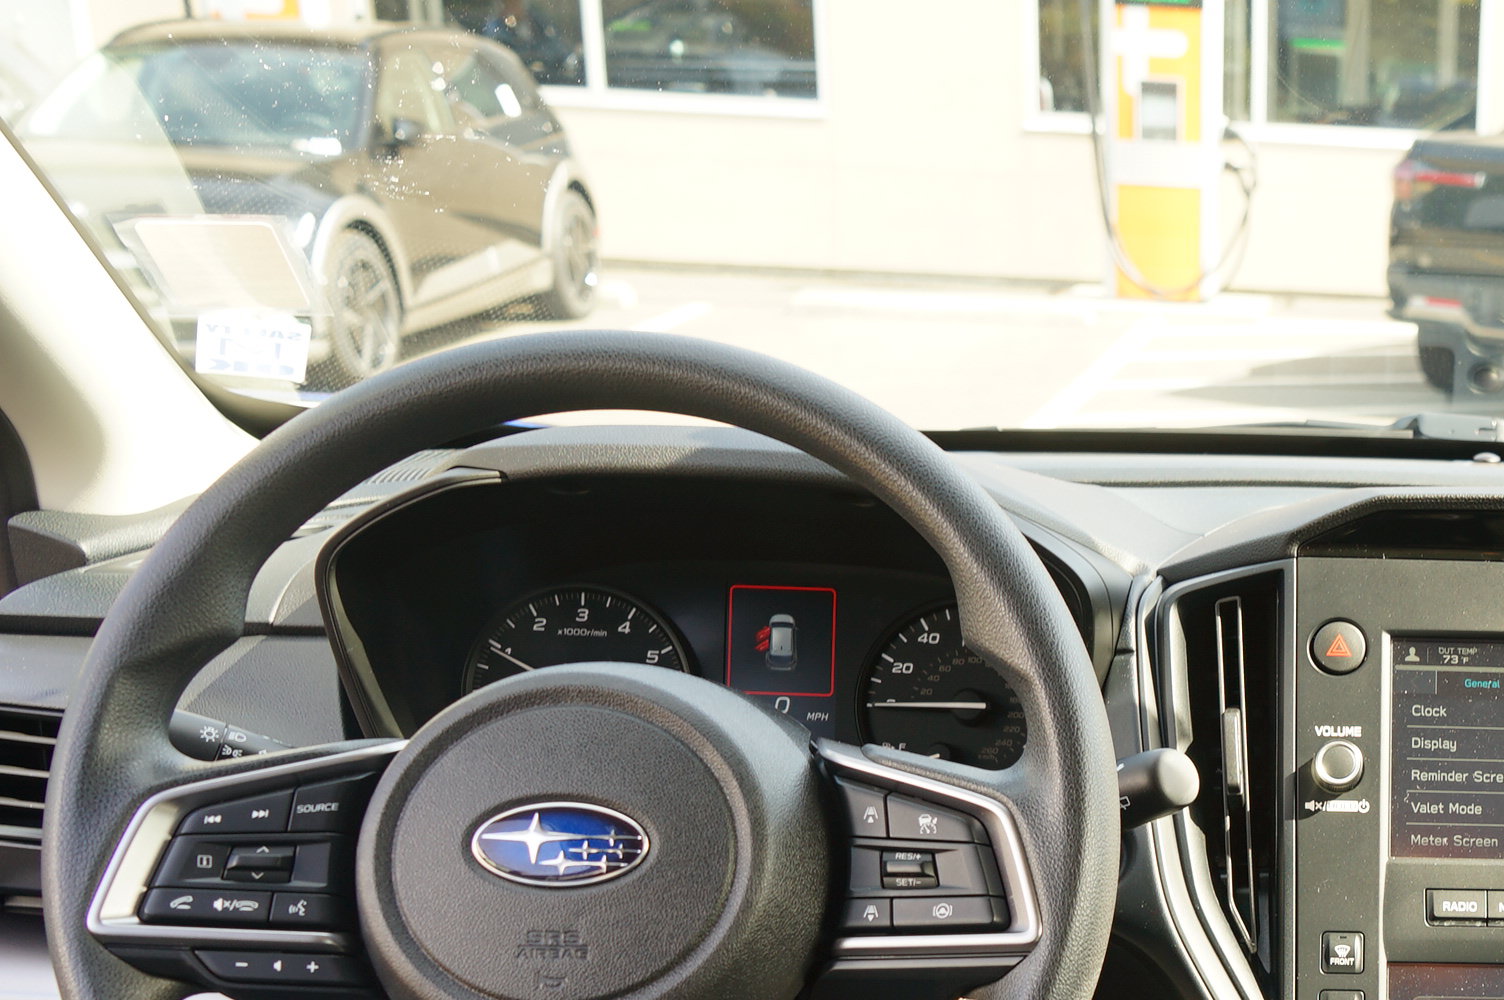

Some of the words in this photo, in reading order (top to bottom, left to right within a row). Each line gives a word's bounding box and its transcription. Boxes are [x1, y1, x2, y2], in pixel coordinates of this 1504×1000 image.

[576, 609, 589, 622] 3
[533, 618, 547, 631] 2
[618, 621, 631, 634] 4
[557, 627, 607, 637] x1000r/min
[917, 633, 940, 645] 40
[1438, 647, 1455, 655] OUT
[1456, 647, 1478, 655] TEMP
[646, 651, 660, 664] 5
[1442, 655, 1459, 664] 73
[892, 663, 914, 674] 20
[1464, 678, 1501, 689] General
[806, 711, 829, 722] MPH
[1411, 704, 1447, 718] Clock
[1314, 725, 1362, 737] VOLUME
[1411, 737, 1457, 752] Display
[1411, 769, 1468, 783] Reminder
[297, 802, 339, 814] SOURCE
[1411, 802, 1444, 815] Valet
[1448, 802, 1482, 815] Mode
[1410, 834, 1448, 847] Meter
[1453, 835, 1498, 848] Screen
[1442, 900, 1478, 913] RADIO
[1330, 957, 1355, 966] FRONT
